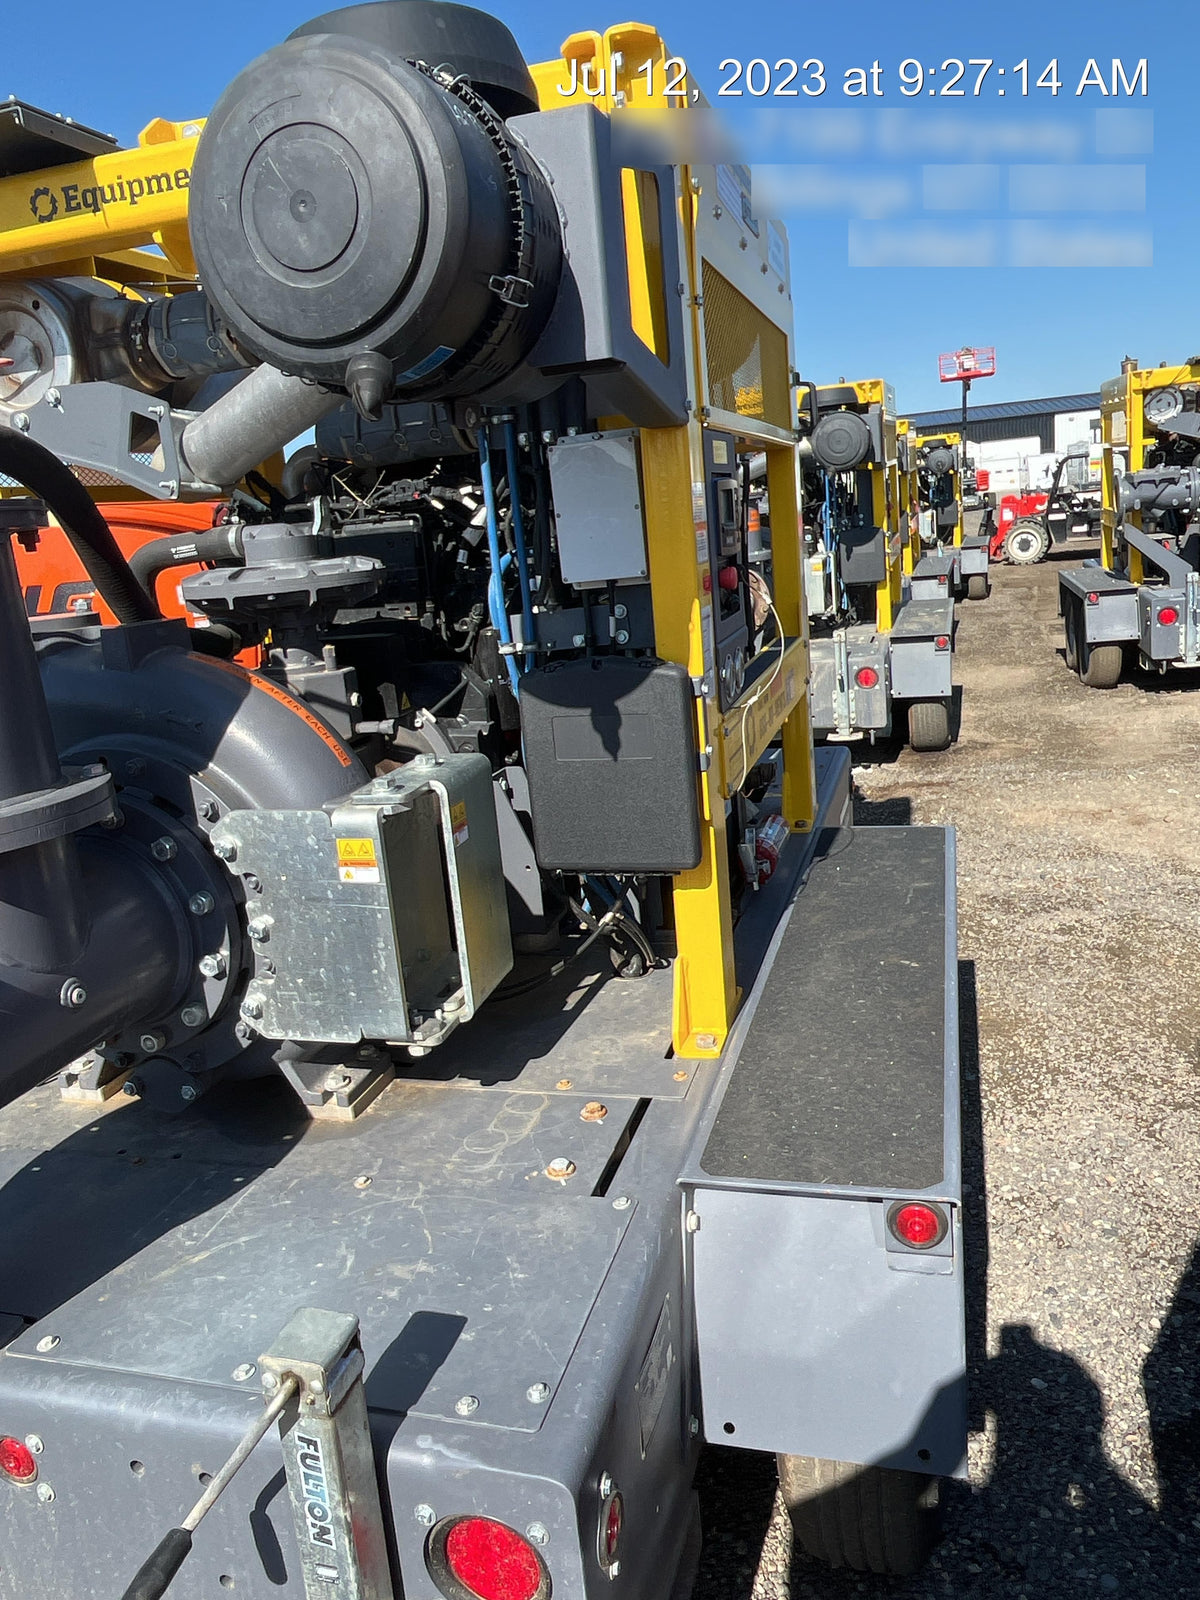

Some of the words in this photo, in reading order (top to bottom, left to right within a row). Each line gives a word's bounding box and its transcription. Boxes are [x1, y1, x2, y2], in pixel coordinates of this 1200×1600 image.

[266, 686, 302, 712] AFTER
[304, 714, 332, 740] EACH
[333, 743, 351, 767] USE
[296, 1431, 336, 1548] FULTON
